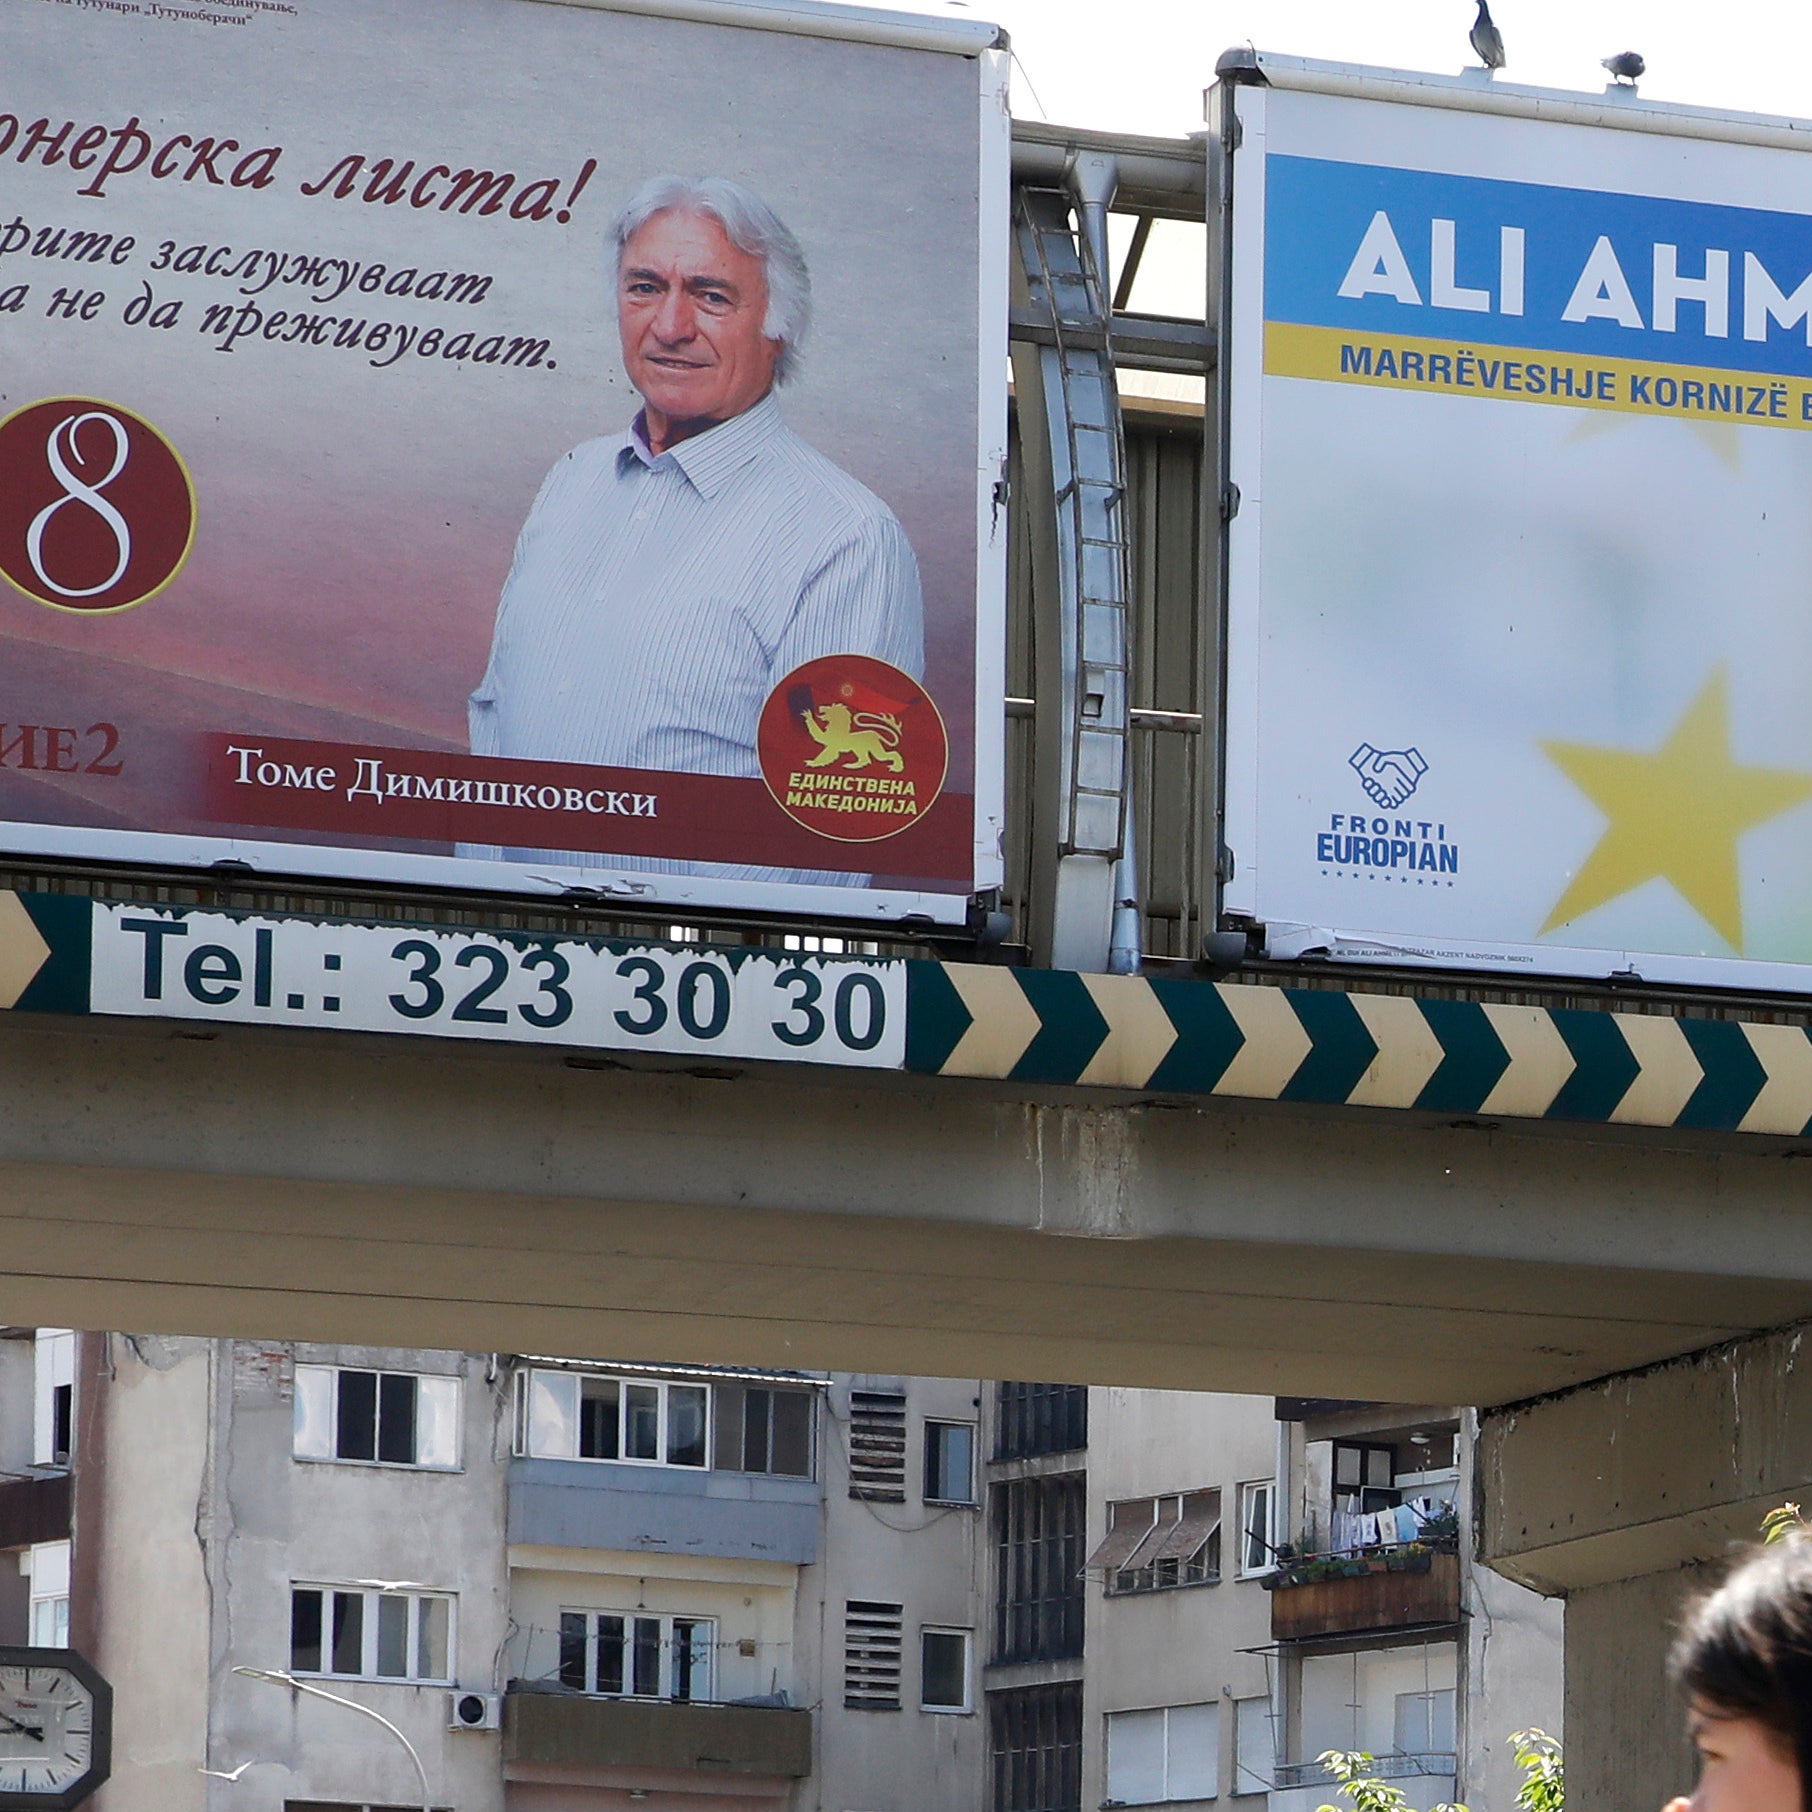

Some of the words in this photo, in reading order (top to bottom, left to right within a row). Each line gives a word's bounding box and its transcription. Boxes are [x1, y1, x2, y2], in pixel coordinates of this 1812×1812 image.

[300, 153, 598, 225] листа!
[149, 238, 495, 303] заслужуваат
[1336, 209, 1525, 316] ALI
[46, 282, 105, 320] не
[122, 279, 184, 329] да
[200, 300, 557, 370] преживуваат.
[1339, 342, 1616, 402] MARRËVESHJE
[1629, 372, 1788, 420] KORNIZË
[26, 412, 131, 597] 8
[226, 744, 336, 792] Томе
[347, 757, 658, 819] Димишковски
[786, 791, 917, 815] МАКЕДОНИЈА
[788, 772, 916, 796] ЕДИНСТВЕНА
[1317, 833, 1458, 873] EUROPIAN
[1331, 814, 1445, 841] FRONTI
[120, 917, 341, 1013] Tel.:
[388, 938, 573, 1029] 323
[613, 950, 732, 1040] 30
[772, 964, 886, 1052] 30
